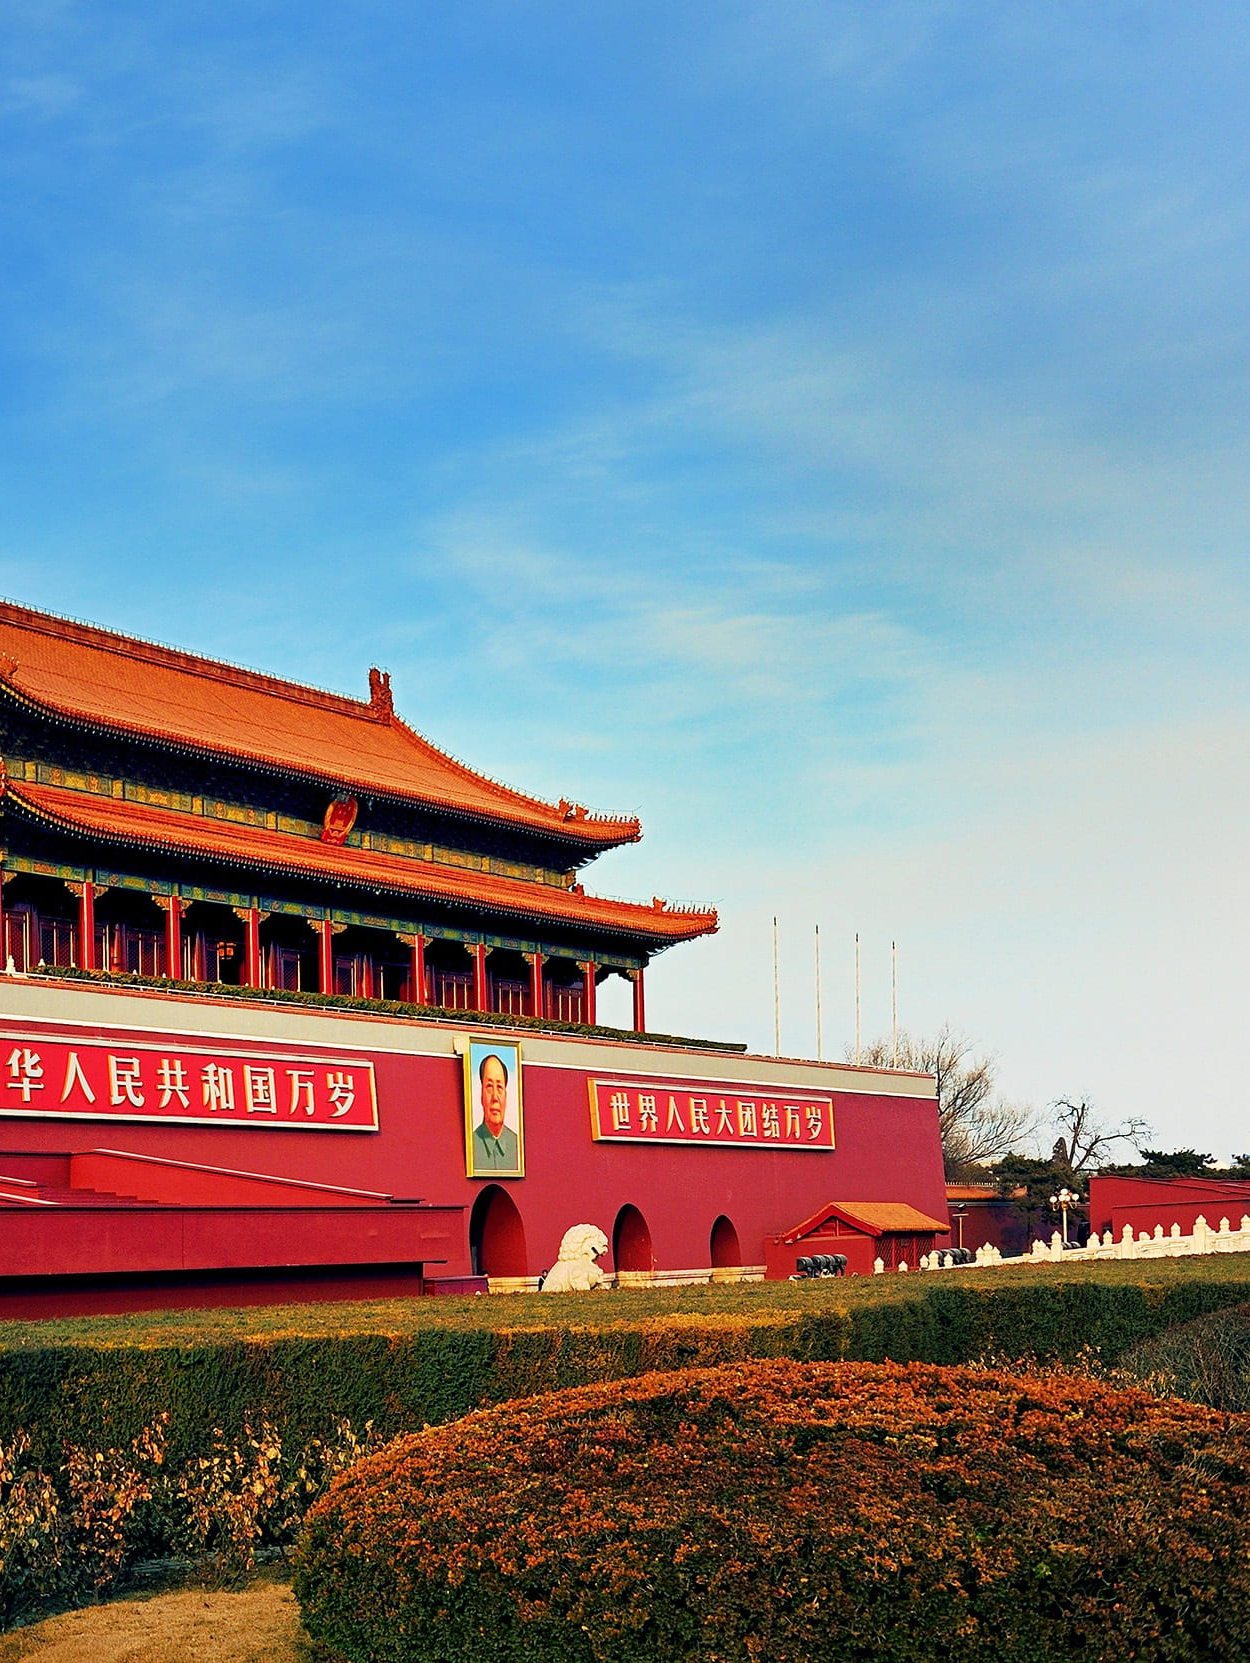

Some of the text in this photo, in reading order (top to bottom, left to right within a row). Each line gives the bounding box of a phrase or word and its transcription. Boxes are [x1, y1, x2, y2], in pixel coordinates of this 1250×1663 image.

[610, 1092, 823, 1140] 世界人民大团结万岁
